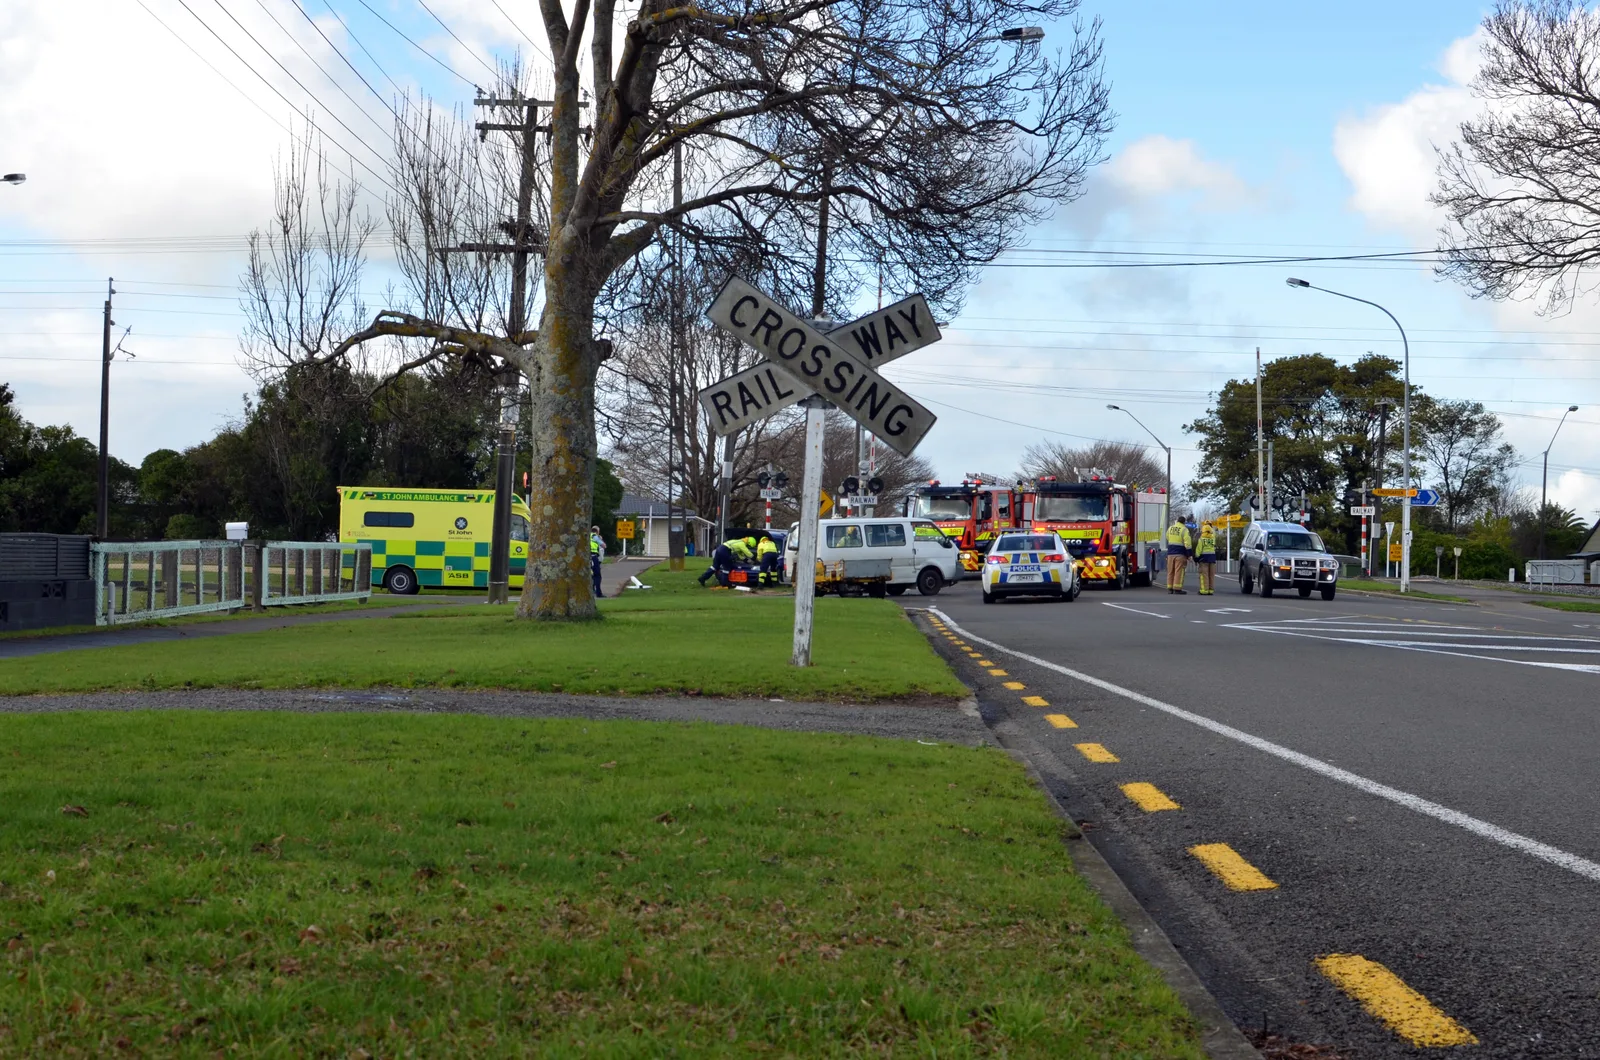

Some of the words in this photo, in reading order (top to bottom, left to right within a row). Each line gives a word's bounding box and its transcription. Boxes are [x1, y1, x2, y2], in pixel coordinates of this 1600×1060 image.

[710, 368, 795, 426] RAIL
[851, 303, 923, 360] WAY
[729, 295, 914, 437] CROSSING
[413, 494, 459, 502] AMBULANCE
[850, 496, 876, 504] RAILWAY
[1170, 526, 1182, 536] FIRE
